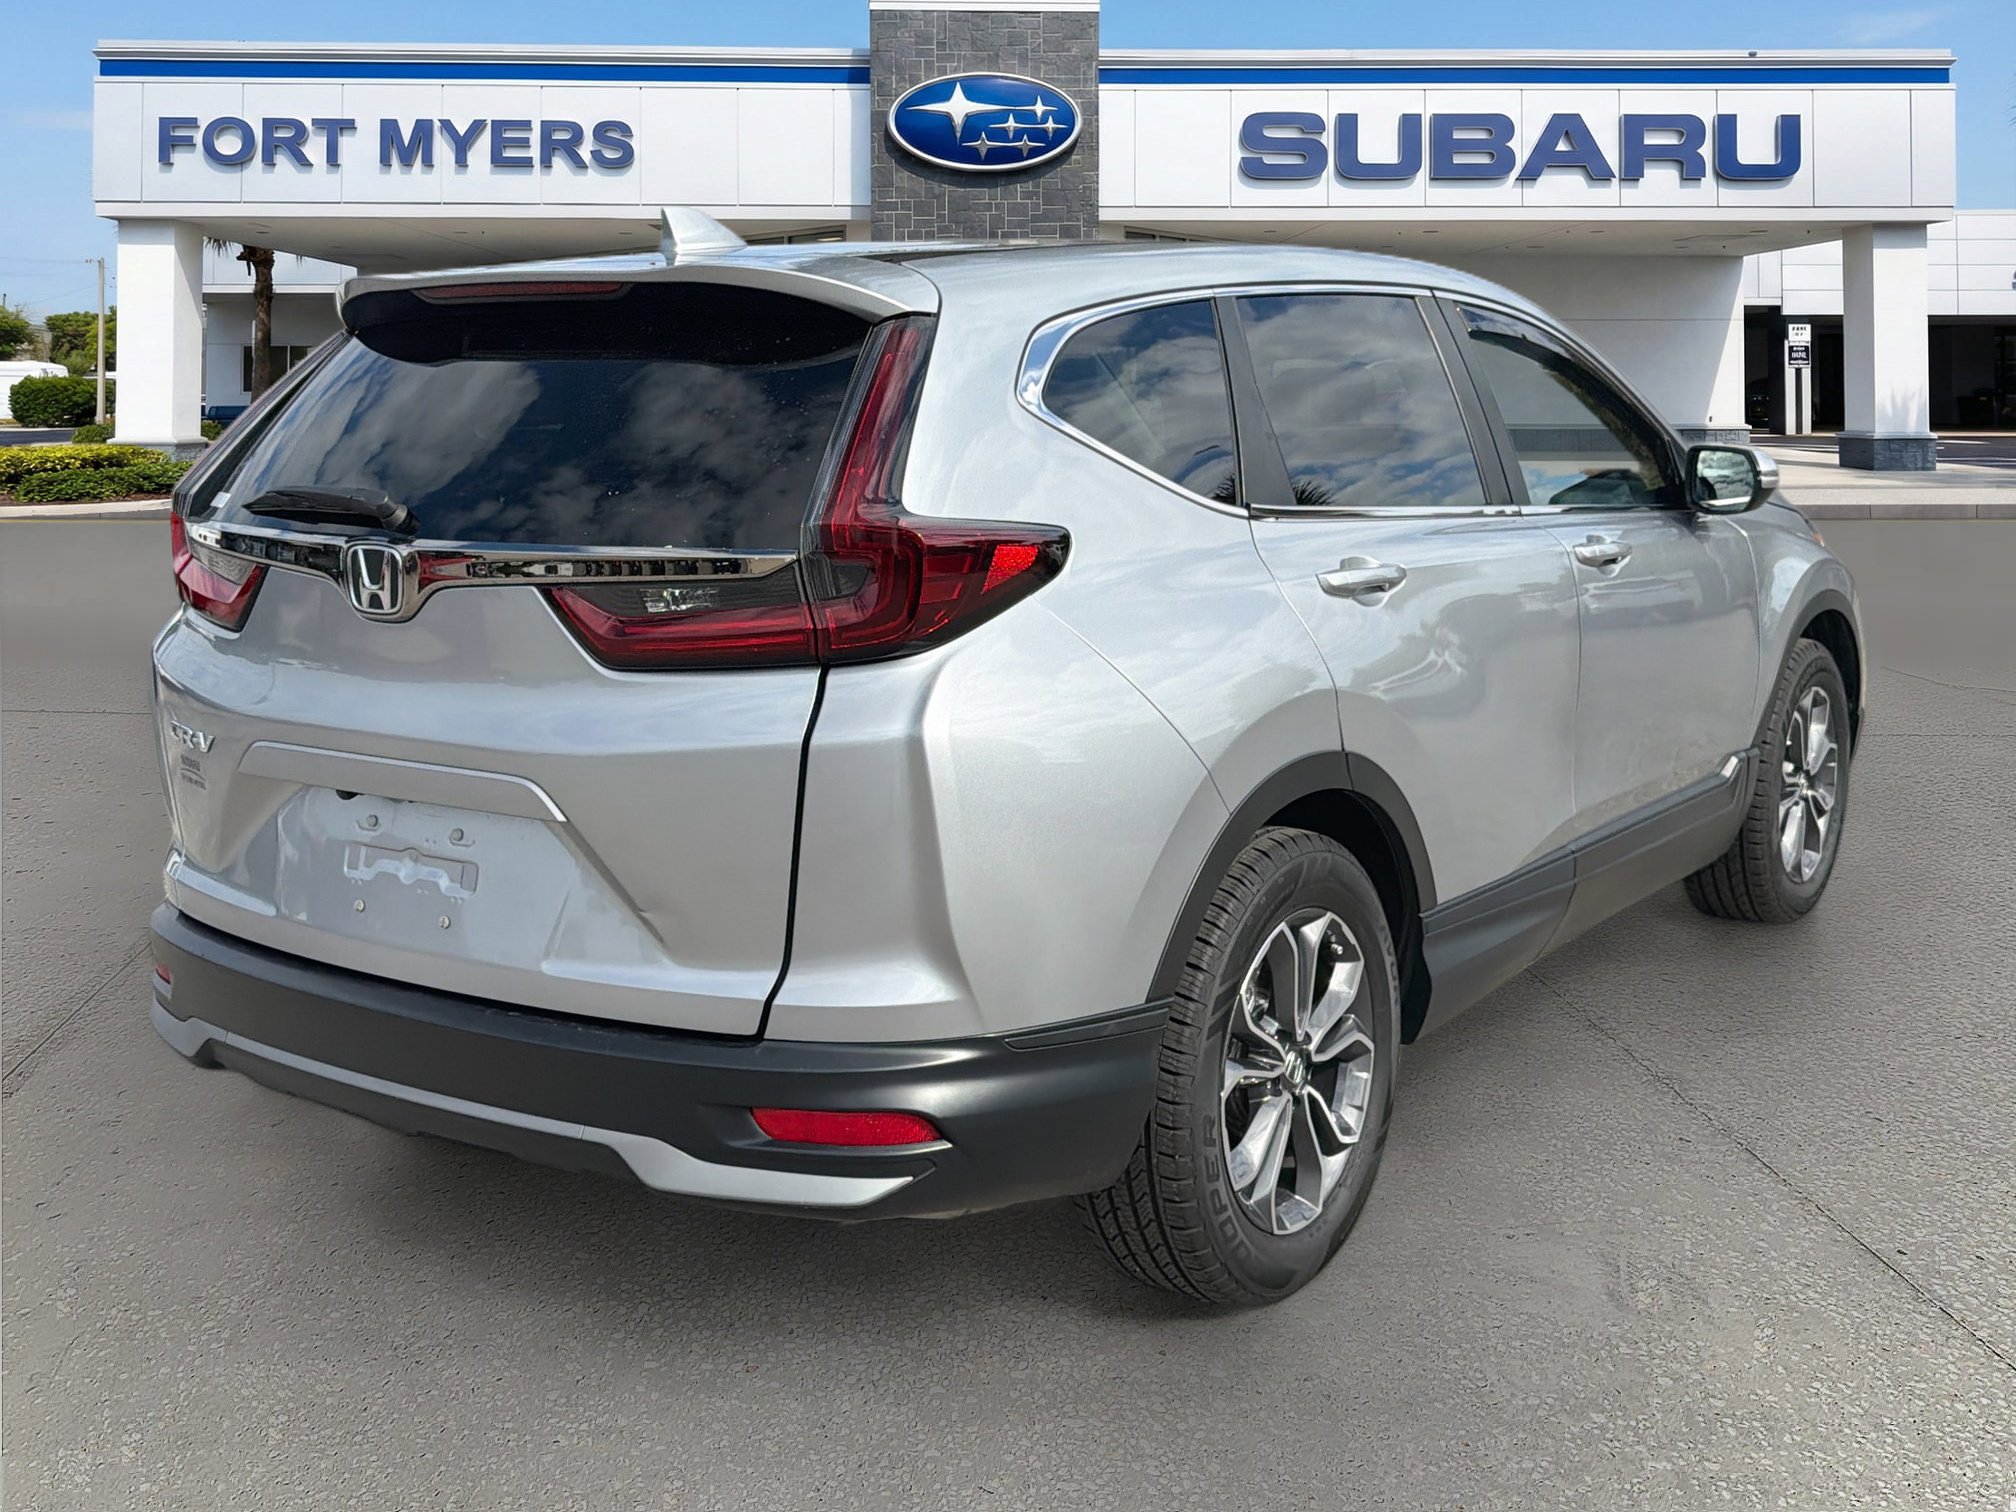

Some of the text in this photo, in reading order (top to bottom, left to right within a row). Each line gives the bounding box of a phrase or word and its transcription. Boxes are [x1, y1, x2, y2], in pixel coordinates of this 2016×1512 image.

[158, 116, 635, 169] FORT MYERS
[1239, 111, 1802, 182] SUBARU
